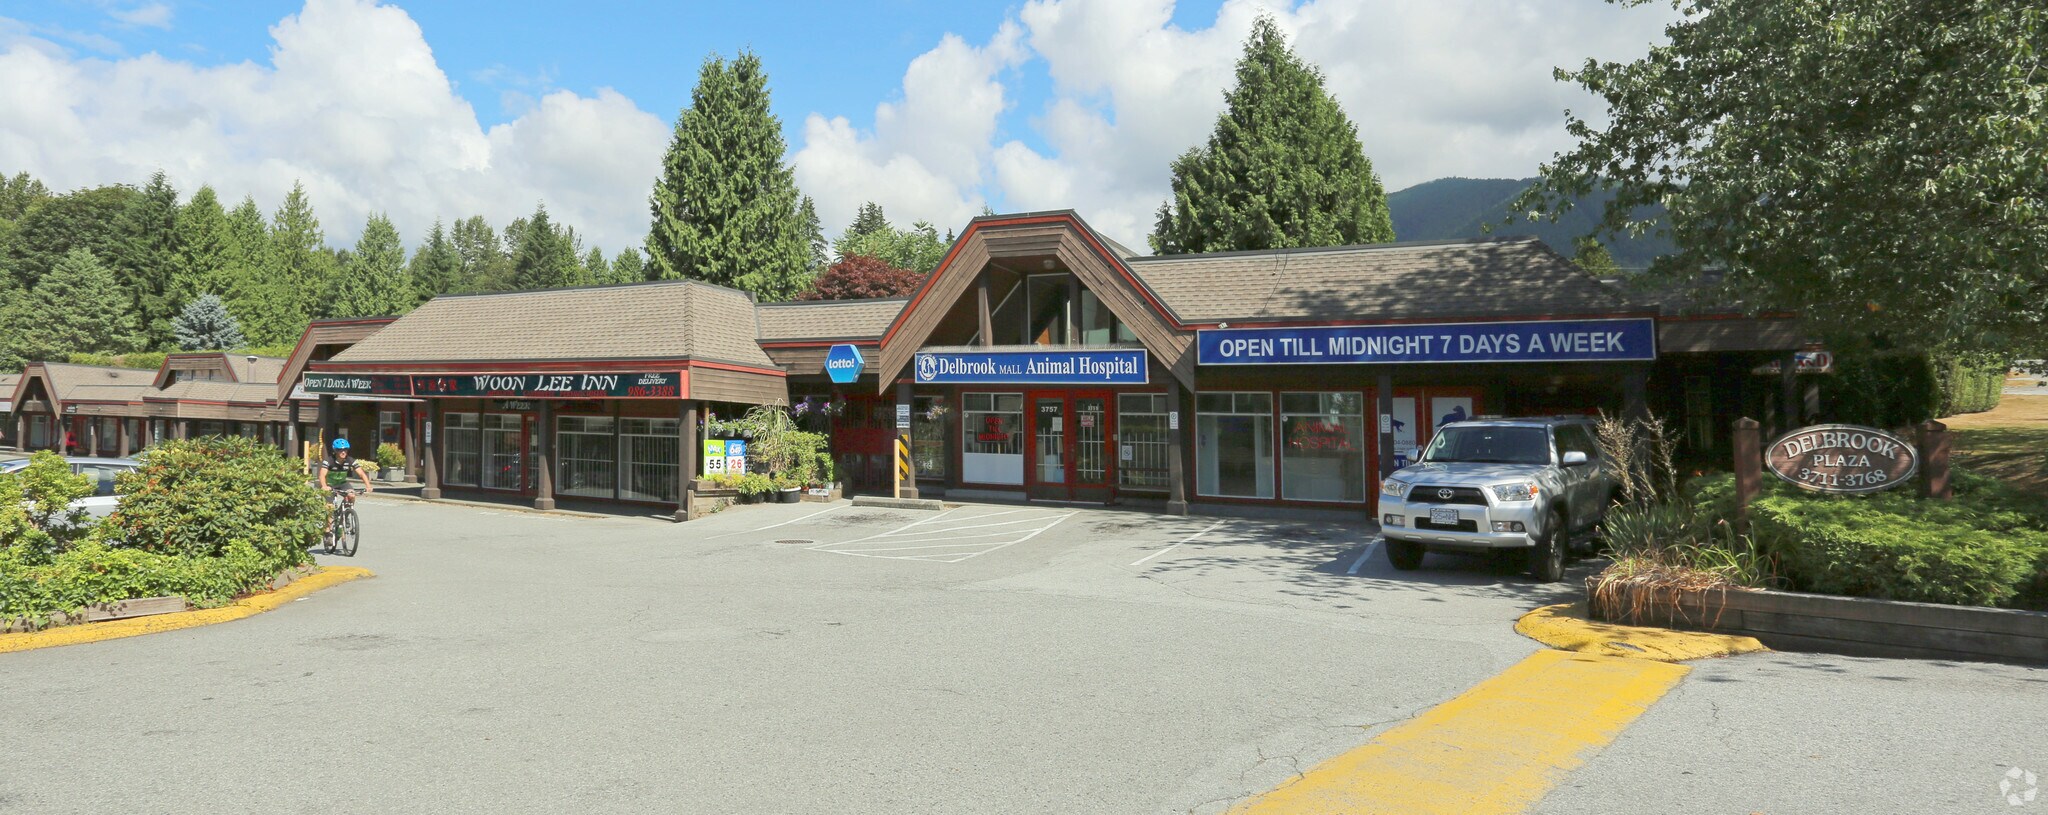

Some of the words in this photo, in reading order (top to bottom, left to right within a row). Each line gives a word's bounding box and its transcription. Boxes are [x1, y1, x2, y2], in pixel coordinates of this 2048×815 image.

[1219, 338, 1274, 357] OPEN
[1279, 337, 1323, 356] TILL
[1328, 335, 1434, 356] MIDNIGHT
[1440, 335, 1452, 354] 7
[1459, 333, 1521, 354] DAYS
[1527, 333, 1545, 353] A
[1549, 331, 1625, 352] WEEK
[938, 357, 997, 375] Delbrook
[999, 364, 1022, 375] MALL
[1025, 357, 1075, 375] Animal
[1078, 356, 1138, 380] Hospital
[304, 377, 322, 388] OPEN
[322, 378, 328, 388] 7
[327, 378, 345, 389] DAYS
[345, 378, 352, 389] A
[351, 378, 372, 390] WEEK
[473, 375, 526, 391] WOON
[534, 374, 574, 391] LEE
[581, 373, 619, 391] INN
[627, 385, 675, 397] 986-3388
[1293, 420, 1350, 434] ANIMAL
[1288, 436, 1357, 451] HOSPITAL
[1783, 431, 1899, 460] DELBROOK
[709, 459, 721, 470] 55
[730, 459, 742, 469] 26
[1813, 455, 1871, 467] PLAZA
[1798, 468, 1887, 487] 3711-3768
